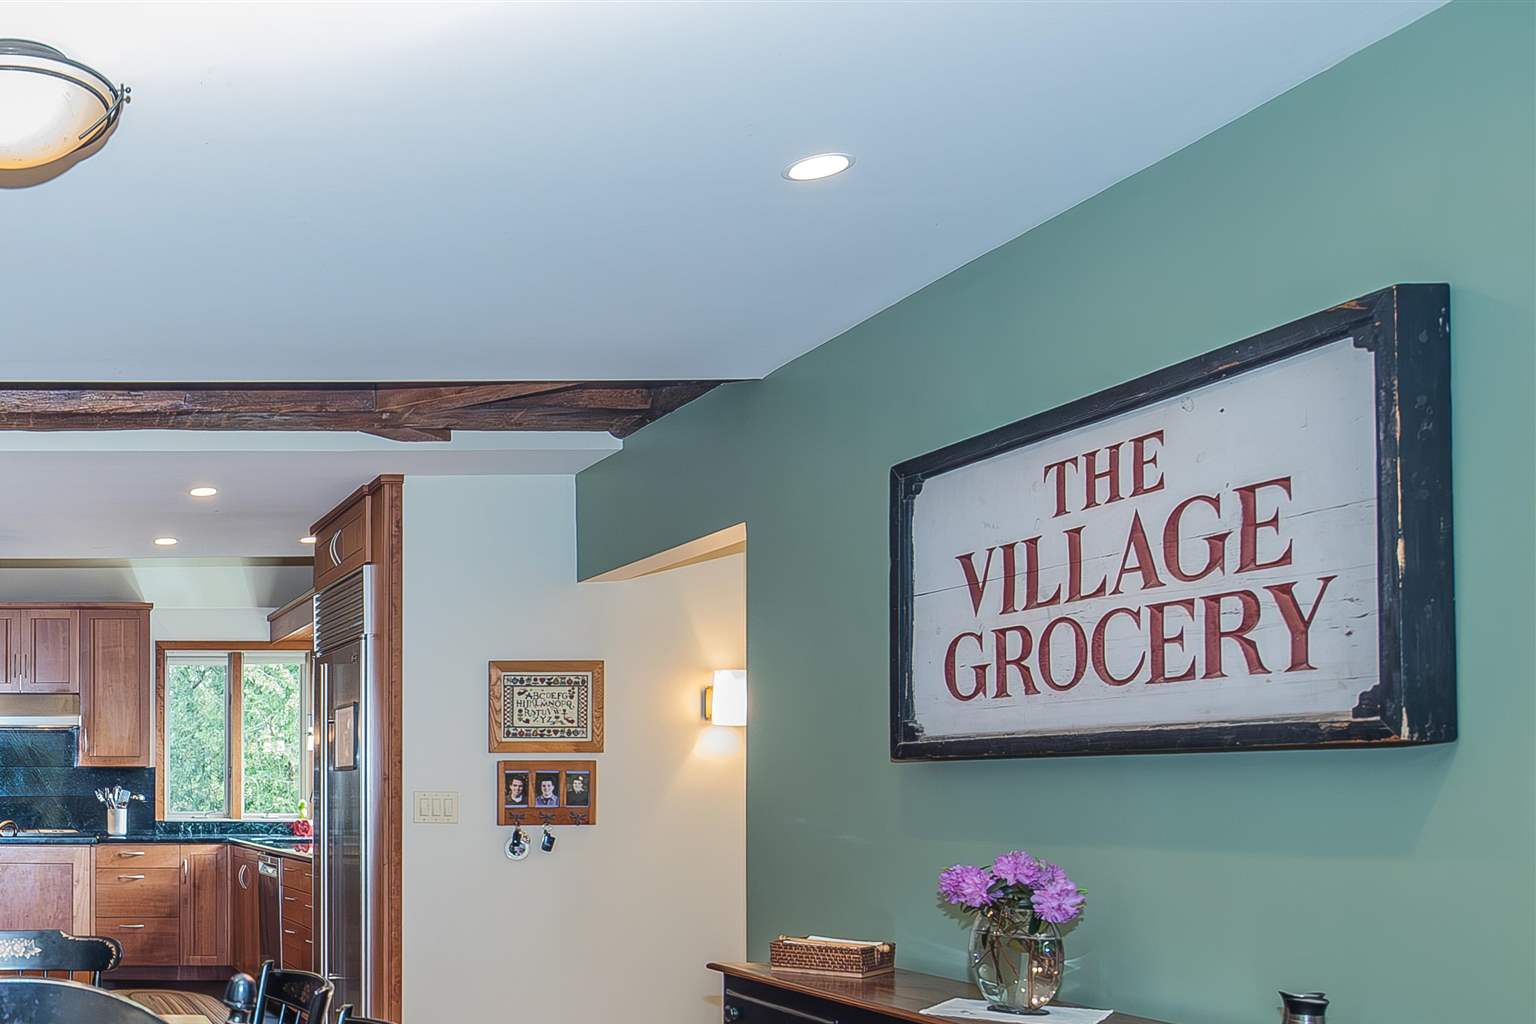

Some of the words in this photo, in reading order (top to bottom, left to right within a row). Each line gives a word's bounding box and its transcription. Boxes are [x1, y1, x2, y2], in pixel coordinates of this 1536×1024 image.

[1043, 429, 1166, 519] THE
[955, 475, 1293, 618] VILLAGE
[943, 574, 1339, 702] GROCERY
